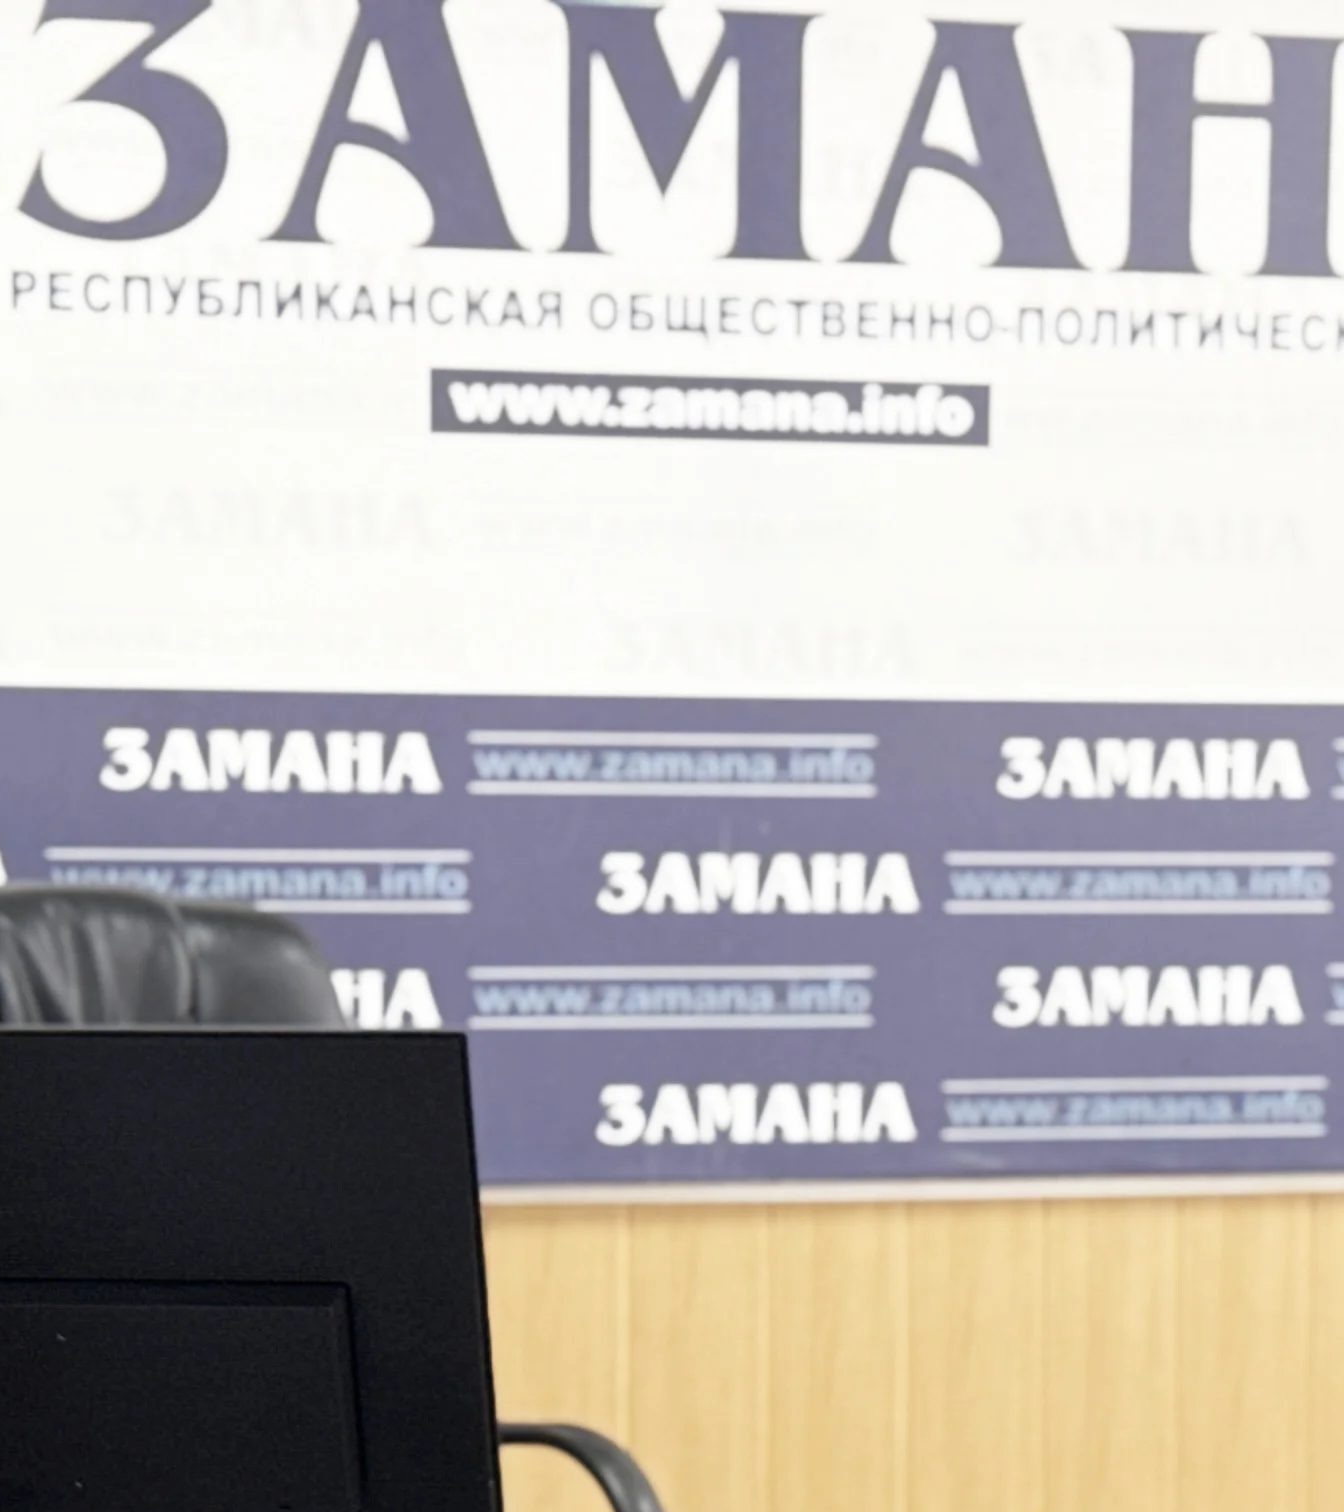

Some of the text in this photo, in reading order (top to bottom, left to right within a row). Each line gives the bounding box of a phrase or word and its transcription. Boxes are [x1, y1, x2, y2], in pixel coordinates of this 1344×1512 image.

[11, 269, 563, 330] РЕСПУБЛИКАНСКАЯ
[448, 381, 976, 437] www.zamana.info
[98, 484, 436, 551] ЗАМАНА
[99, 727, 442, 794] ЗАМАНА
[473, 746, 875, 784] www.zamana.info
[996, 737, 1310, 800] ЗАМАНА
[596, 852, 920, 915] ЗАМАНА
[949, 865, 1333, 900] www.zamana.info
[473, 977, 873, 1016] www.zamana.info
[992, 965, 1305, 1029] ЗАМАНА
[596, 1082, 918, 1146] ЗАМАНА
[946, 1091, 1327, 1126] www.zamana.info
